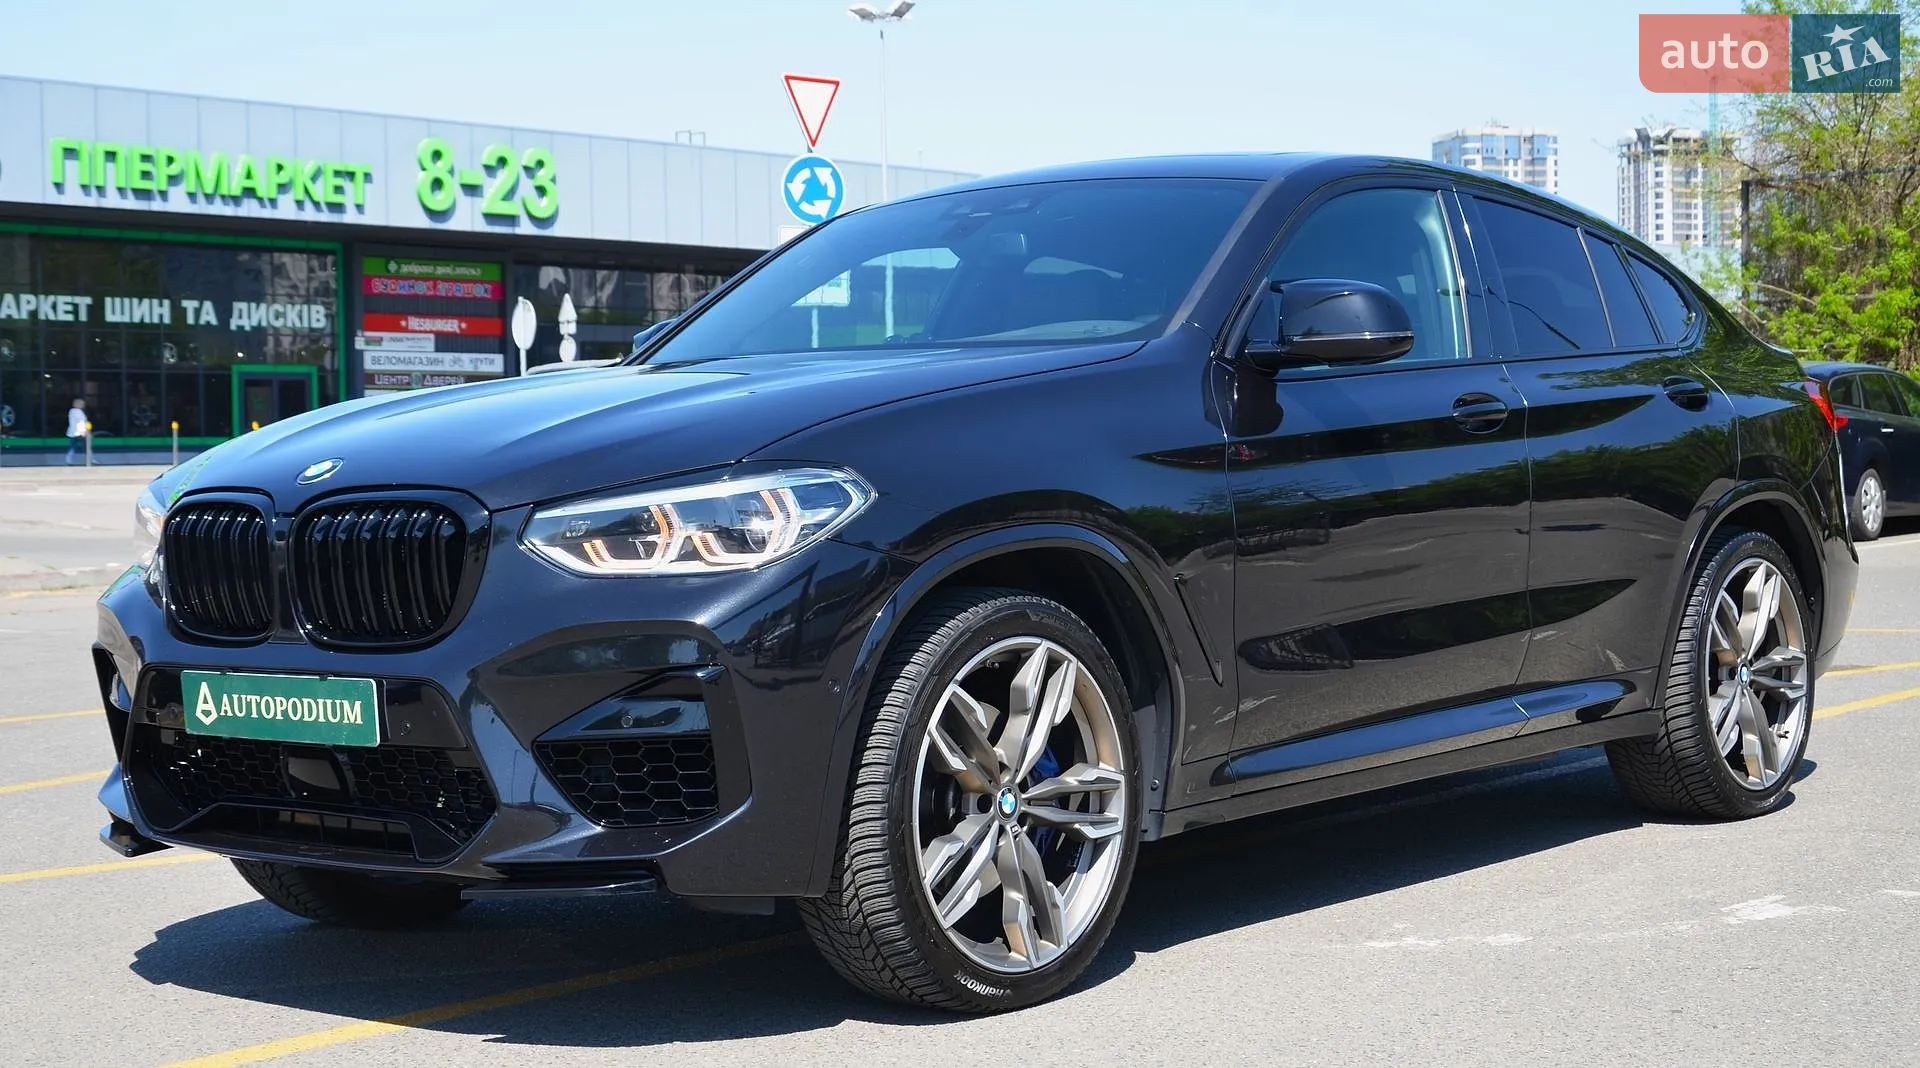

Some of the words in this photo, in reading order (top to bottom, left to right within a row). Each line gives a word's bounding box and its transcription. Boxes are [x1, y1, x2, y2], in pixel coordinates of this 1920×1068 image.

[51, 138, 371, 206] ГІПЕРМАРКЕТ
[417, 137, 559, 220] 8-23
[104, 296, 171, 324] ШИН
[181, 299, 218, 325] ТА
[230, 301, 328, 330] ДИСКІВ
[371, 354, 445, 367] ВЕЛОМАГАЗИН
[219, 694, 363, 725] AUTOPODIUM
